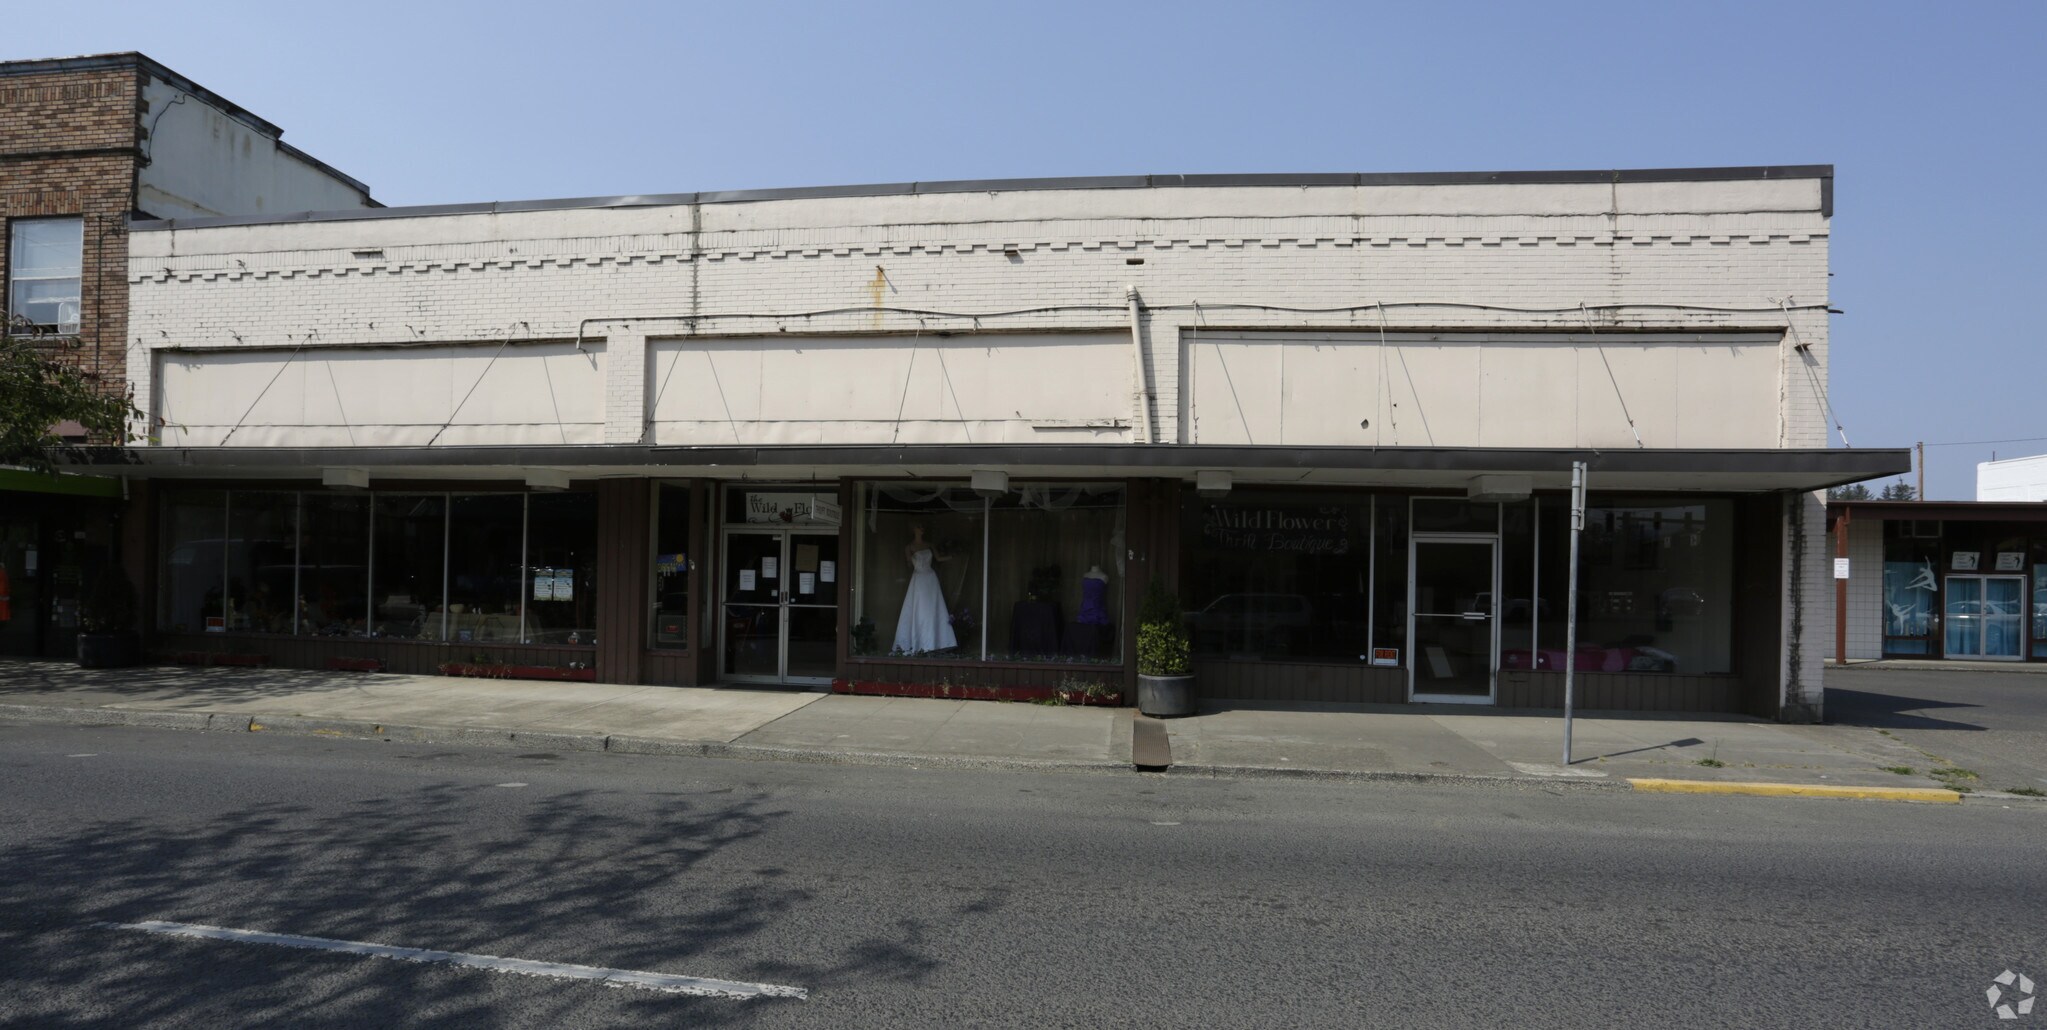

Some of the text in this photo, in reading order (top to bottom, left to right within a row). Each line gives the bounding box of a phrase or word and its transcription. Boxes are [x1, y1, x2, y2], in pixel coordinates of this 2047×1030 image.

[750, 494, 763, 503] the
[750, 502, 778, 513] Wild
[794, 502, 812, 514] Flo
[1268, 532, 1334, 553] Boutique
